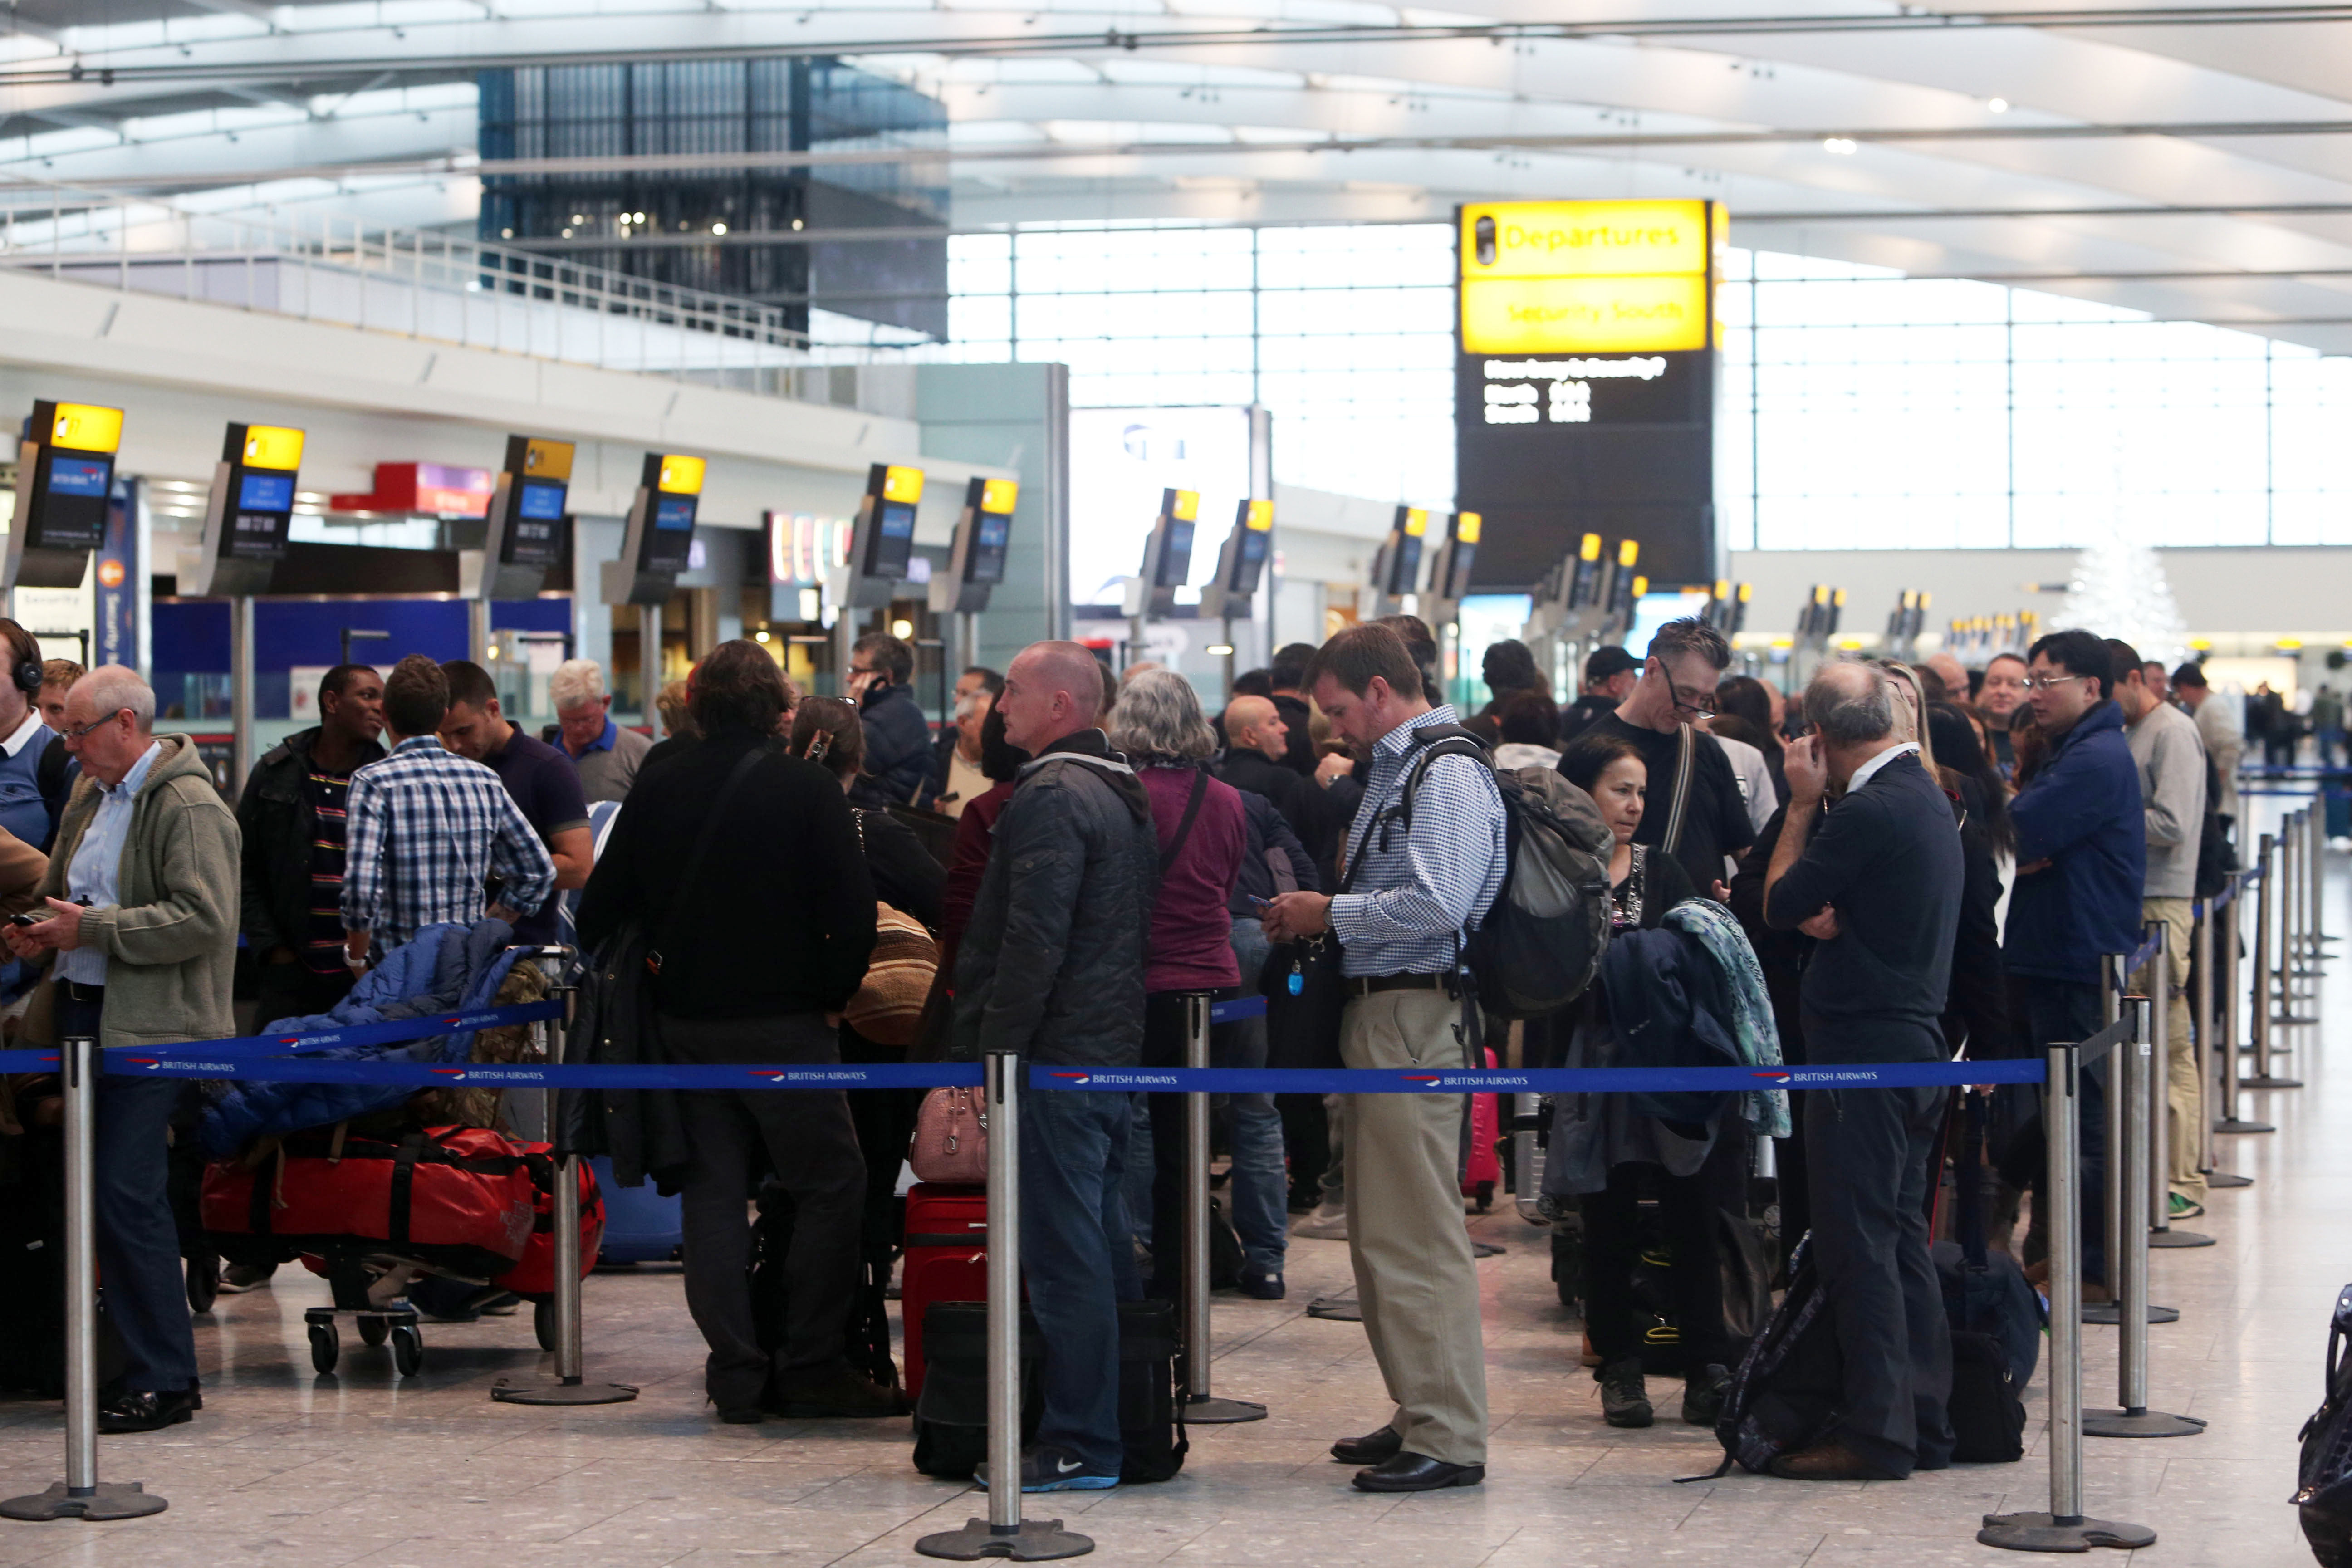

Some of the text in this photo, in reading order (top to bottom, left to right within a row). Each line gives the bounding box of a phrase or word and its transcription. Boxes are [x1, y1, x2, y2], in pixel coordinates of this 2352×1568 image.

[1505, 225, 1680, 253] Departures
[162, 1061, 235, 1072] BRITISH AIRWAYS
[468, 1071, 544, 1080] BRITISH AIRWAYS
[788, 1072, 867, 1080] BRITISH AIRWAYS
[1093, 1074, 1177, 1084] BRITISH AIRWAYS
[1793, 1072, 1878, 1081] BRITISH AIRWAYS
[1444, 1077, 1528, 1085] BRITISH AIRWAYS
